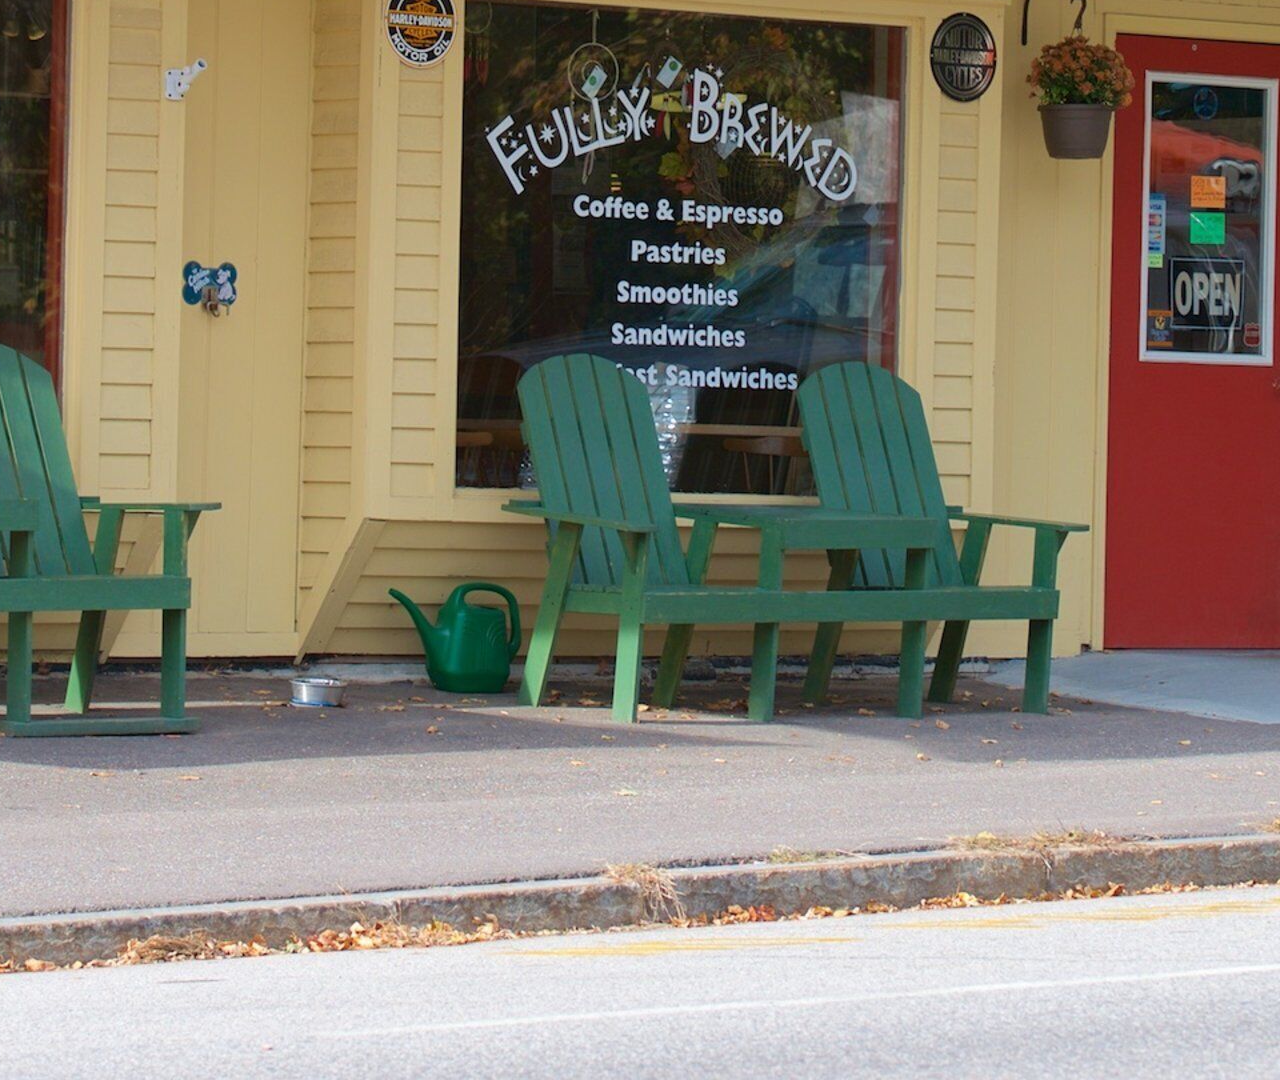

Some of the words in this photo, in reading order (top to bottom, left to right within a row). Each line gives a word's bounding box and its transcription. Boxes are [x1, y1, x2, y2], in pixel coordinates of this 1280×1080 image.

[390, 14, 452, 28] HARLEY-DAVIDSON
[392, 34, 428, 61] MOTOR
[433, 39, 451, 56] OIL
[485, 86, 651, 195] FULLY
[689, 67, 858, 201] BREWED
[572, 194, 650, 221] Coffee
[656, 199, 675, 222] &
[682, 199, 784, 229] Espresso
[630, 239, 727, 266] Pastries
[616, 280, 739, 307] Smoothies
[1174, 270, 1242, 318] OPEN
[611, 322, 746, 348] Sandwiches
[665, 364, 798, 391] Sandwiches
